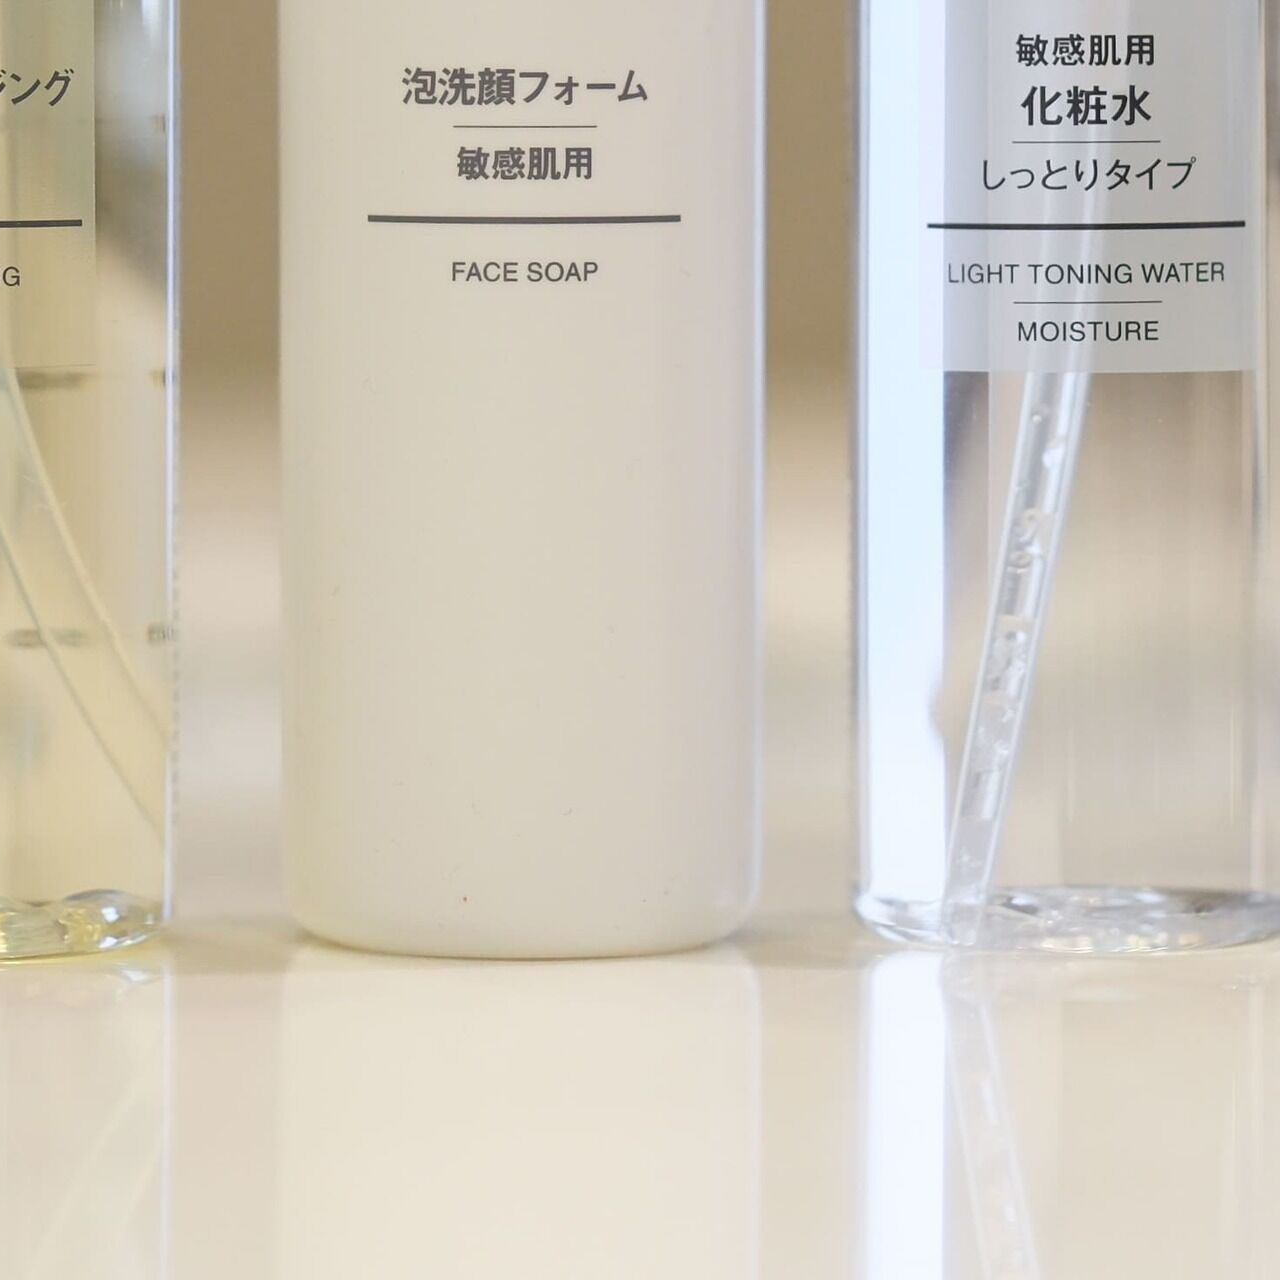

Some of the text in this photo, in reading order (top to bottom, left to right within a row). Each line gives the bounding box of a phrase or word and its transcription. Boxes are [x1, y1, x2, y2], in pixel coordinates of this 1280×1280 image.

[1015, 33, 1155, 67] 敏感肌用
[401, 66, 649, 106] 泡洗顔フォーム
[1020, 84, 1152, 126] 化粧水
[456, 146, 593, 181] 敏感肌用
[982, 156, 1197, 192] しっとりタイプ
[451, 261, 599, 283] FACE SOAP
[947, 261, 1225, 285] LIGHT TONING WATER
[1017, 320, 1160, 343] MOISTURE
